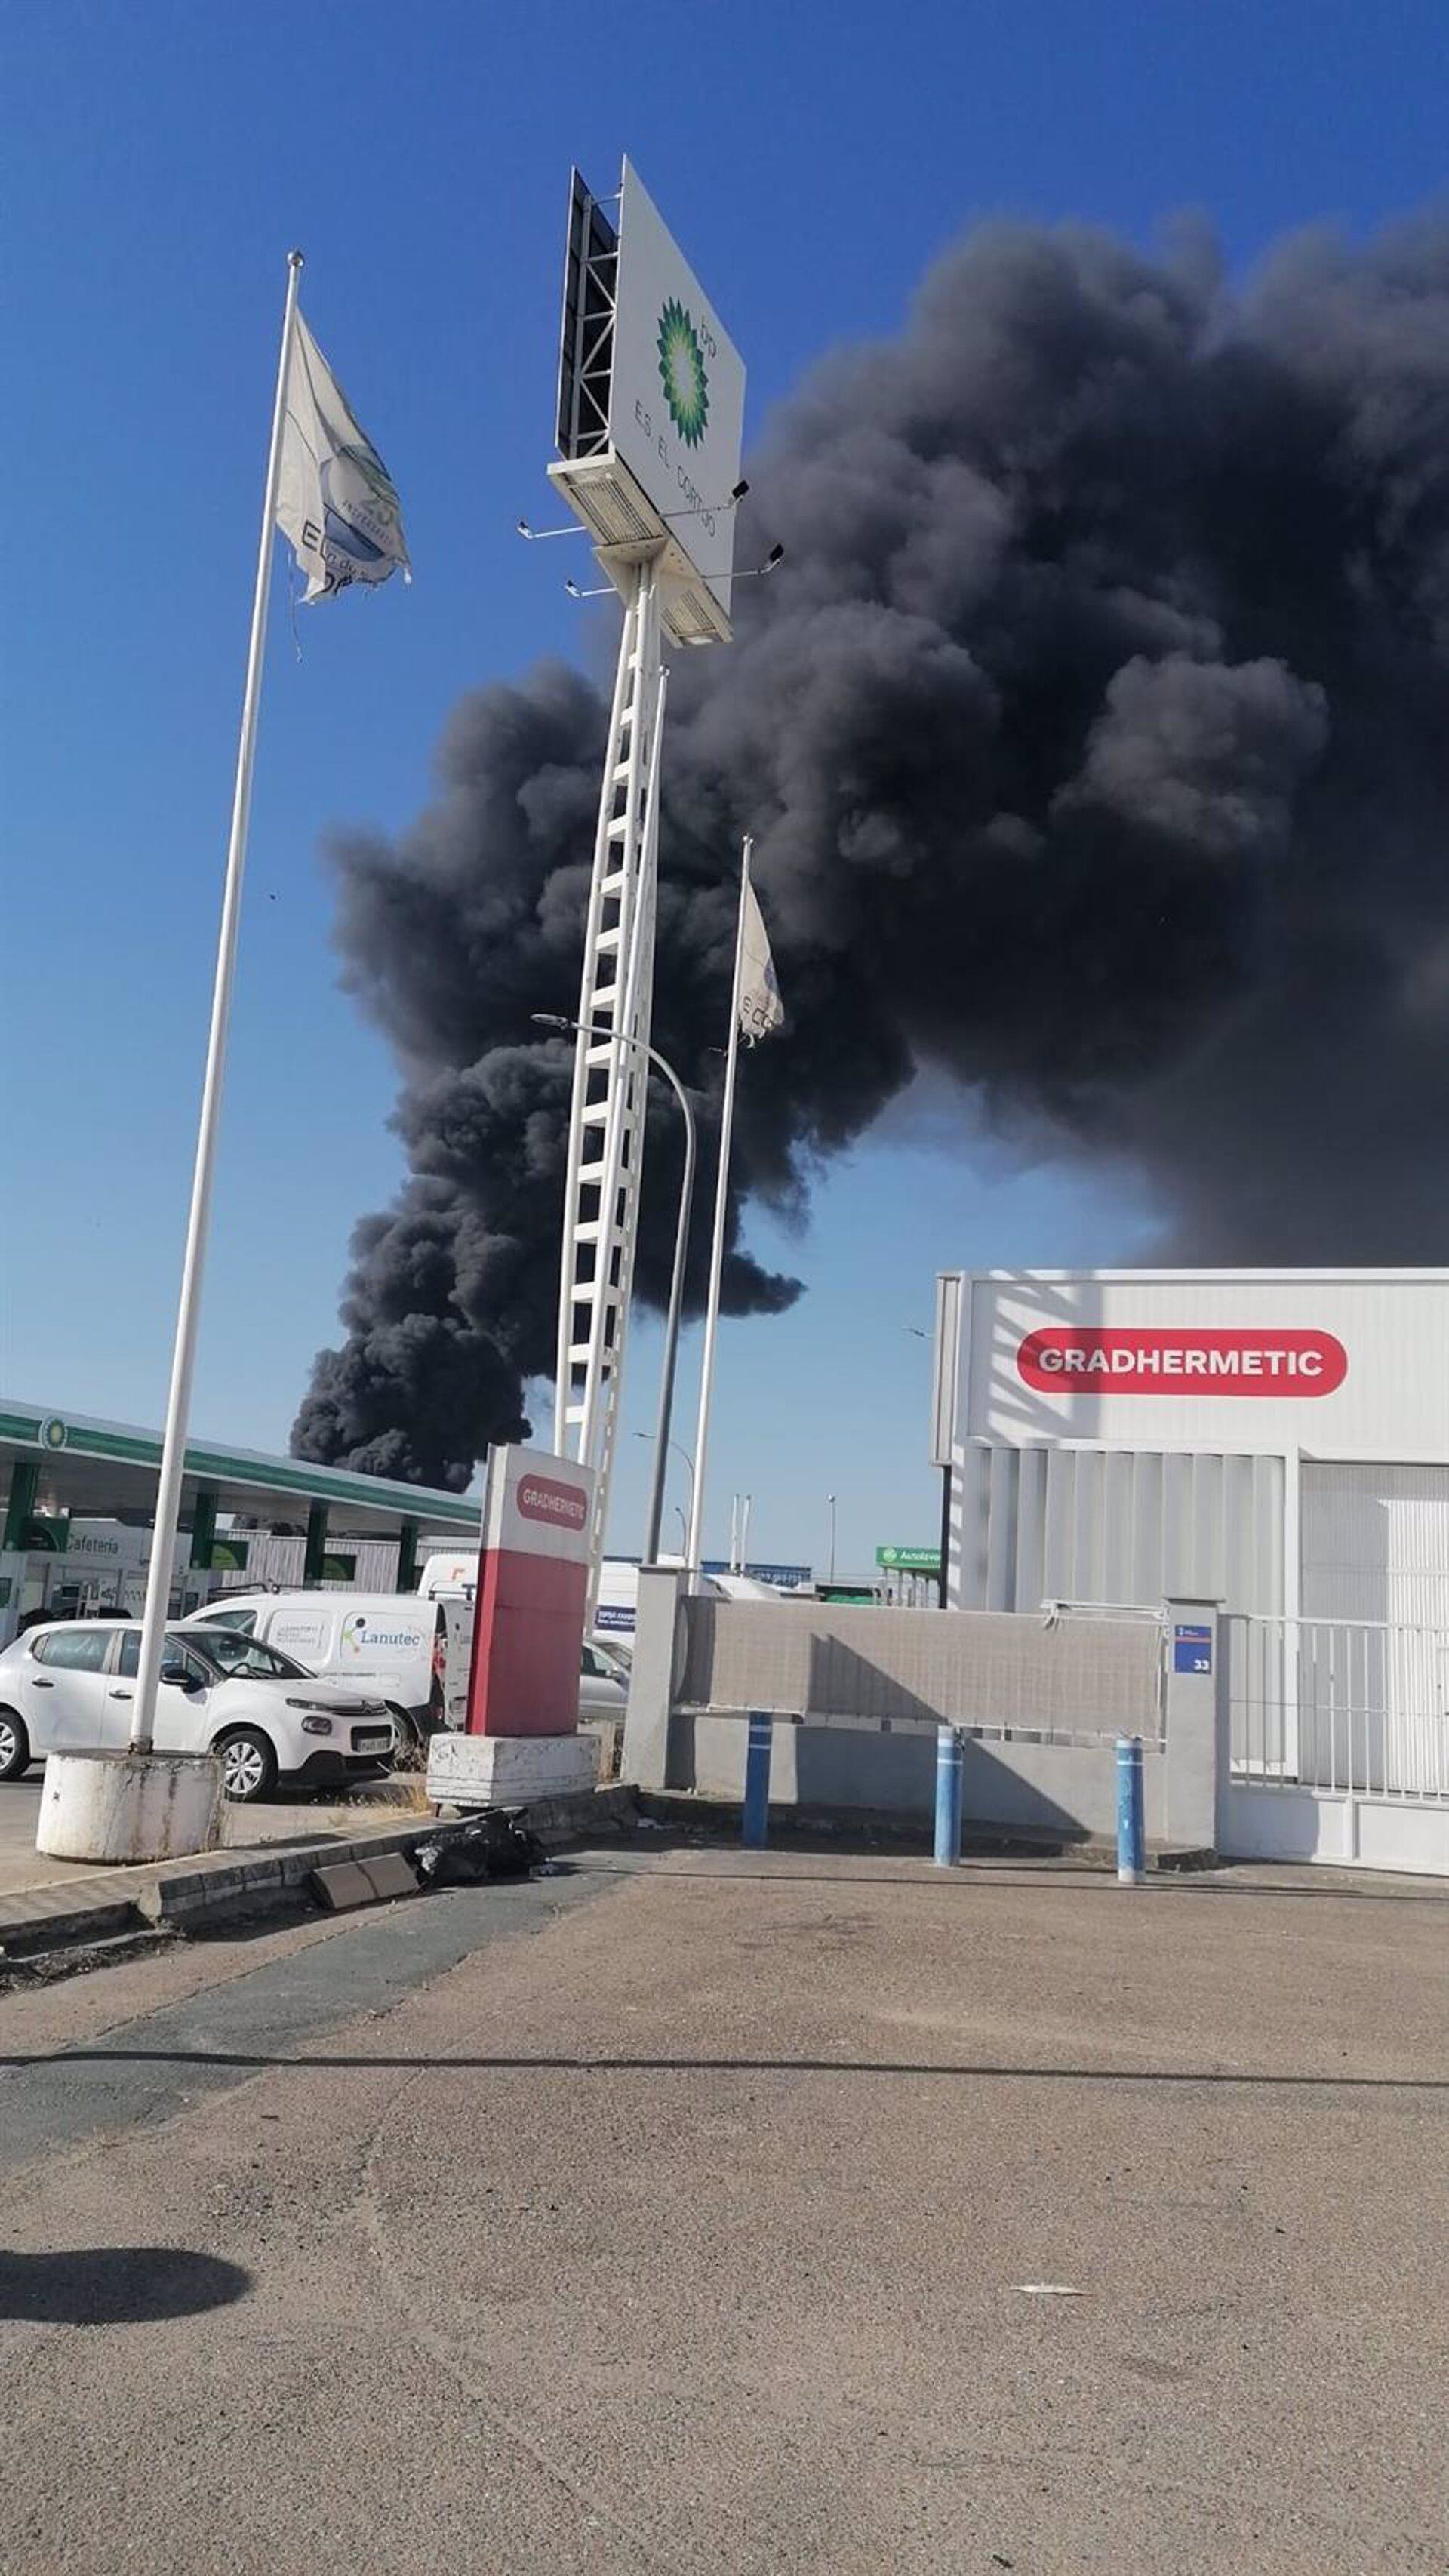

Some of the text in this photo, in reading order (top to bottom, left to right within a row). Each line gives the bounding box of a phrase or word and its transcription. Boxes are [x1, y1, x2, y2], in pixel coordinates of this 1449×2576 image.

[1038, 1347, 1324, 1377] GRADHERMETIC
[360, 1631, 420, 1646] Lanutec
[1193, 1659, 1210, 1670] 33
